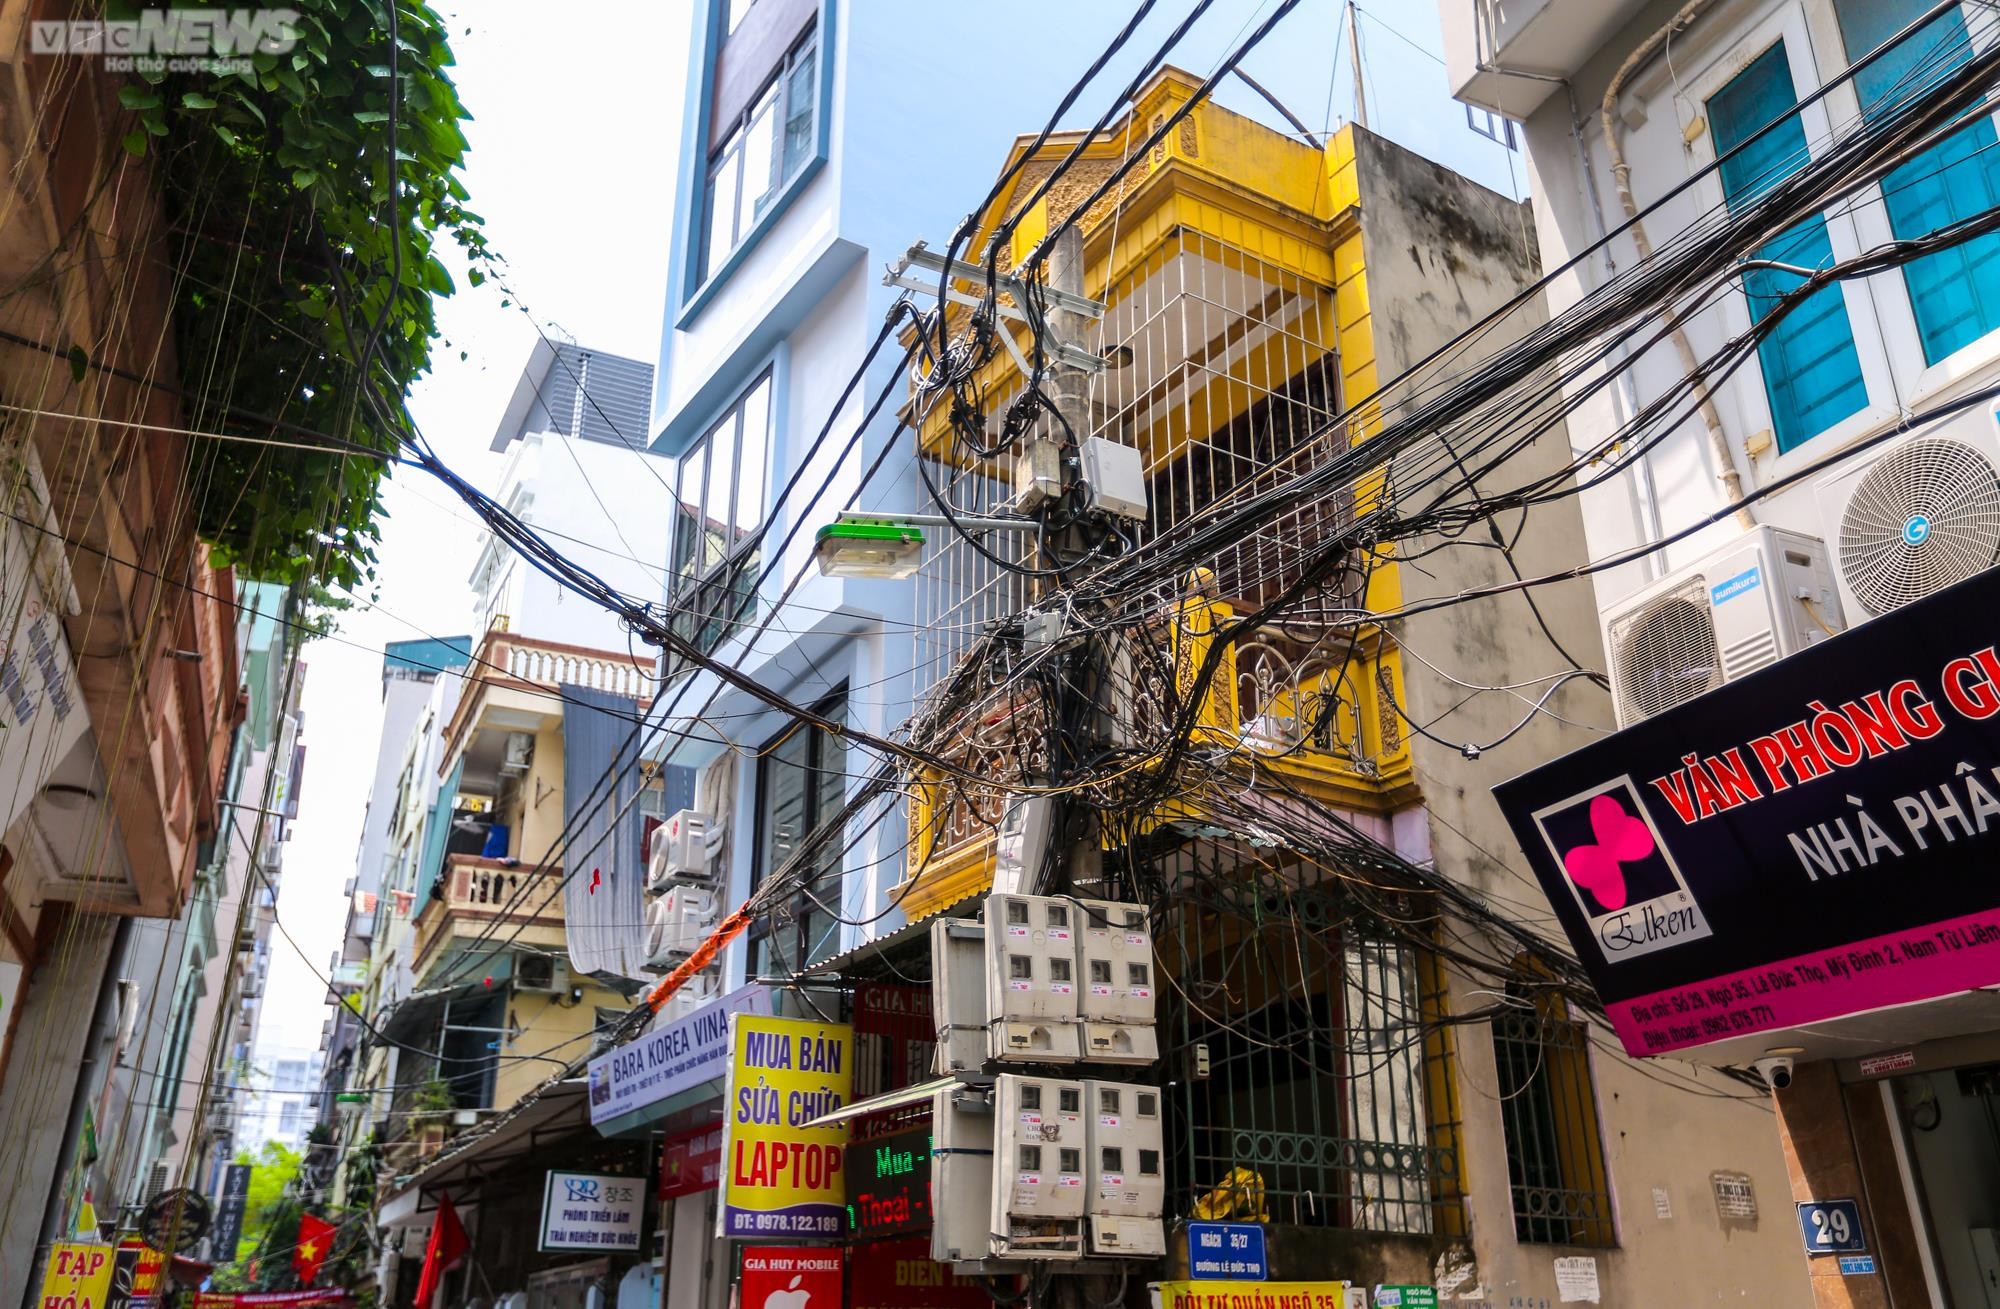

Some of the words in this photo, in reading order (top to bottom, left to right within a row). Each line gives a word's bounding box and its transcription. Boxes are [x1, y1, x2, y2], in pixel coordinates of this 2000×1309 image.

[1714, 575, 1757, 601] sumikura
[1648, 753, 1764, 825] VĂN
[1747, 680, 1945, 792] PHÒNG
[1787, 794, 1904, 882] NHÀ
[1893, 761, 2000, 850] PHÂ
[1601, 904, 1697, 951] Elken
[1631, 1005, 1653, 1025] Địa
[1670, 990, 1690, 1014] Số
[1687, 991, 1709, 1010] 29,
[1706, 983, 1734, 1008] Ngõ
[1731, 980, 1754, 1001] 35,
[1751, 974, 1770, 995] Lê
[1768, 968, 1797, 991] Đức
[1793, 964, 1829, 985] Thọ,
[1825, 955, 1851, 980] Mỹ
[1850, 949, 1885, 973] Đình
[1883, 944, 1904, 967] 2,
[1900, 938, 1939, 962] Nam
[1935, 930, 1962, 951] Từ
[865, 987, 906, 1010] GIA
[1643, 1029, 1670, 1050] Điện
[1700, 1014, 1732, 1037] 0962
[1750, 1004, 1776, 1026] 771
[613, 1047, 645, 1083] BARA
[648, 1026, 690, 1069] KOREA
[693, 1008, 728, 1047] VINA
[745, 1031, 792, 1070] MUA
[799, 1031, 842, 1074] BÁN
[737, 1075, 780, 1126] SỬA
[788, 1086, 844, 1130] CHỮA
[734, 1139, 842, 1190] LAPTOP
[876, 1146, 914, 1178] Mua
[604, 1185, 633, 1204] 창조
[858, 1186, 910, 1228] Thoại
[756, 1214, 839, 1232] 0978.122.189
[1200, 1230, 1222, 1248] NGÁCH
[1230, 1232, 1249, 1249] 35/27
[1811, 1208, 1851, 1244] 29
[57, 1250, 105, 1282] TẠP
[745, 1258, 767, 1269] GIA
[769, 1258, 795, 1270] HUY
[797, 1259, 840, 1270] MOBILE
[1196, 1259, 1220, 1272] ĐƯỜNG
[1220, 1259, 1230, 1272] LÊ
[1230, 1260, 1246, 1273] ĐỨC
[1246, 1262, 1261, 1275] THỌ
[1315, 1295, 1335, 1309] 35
